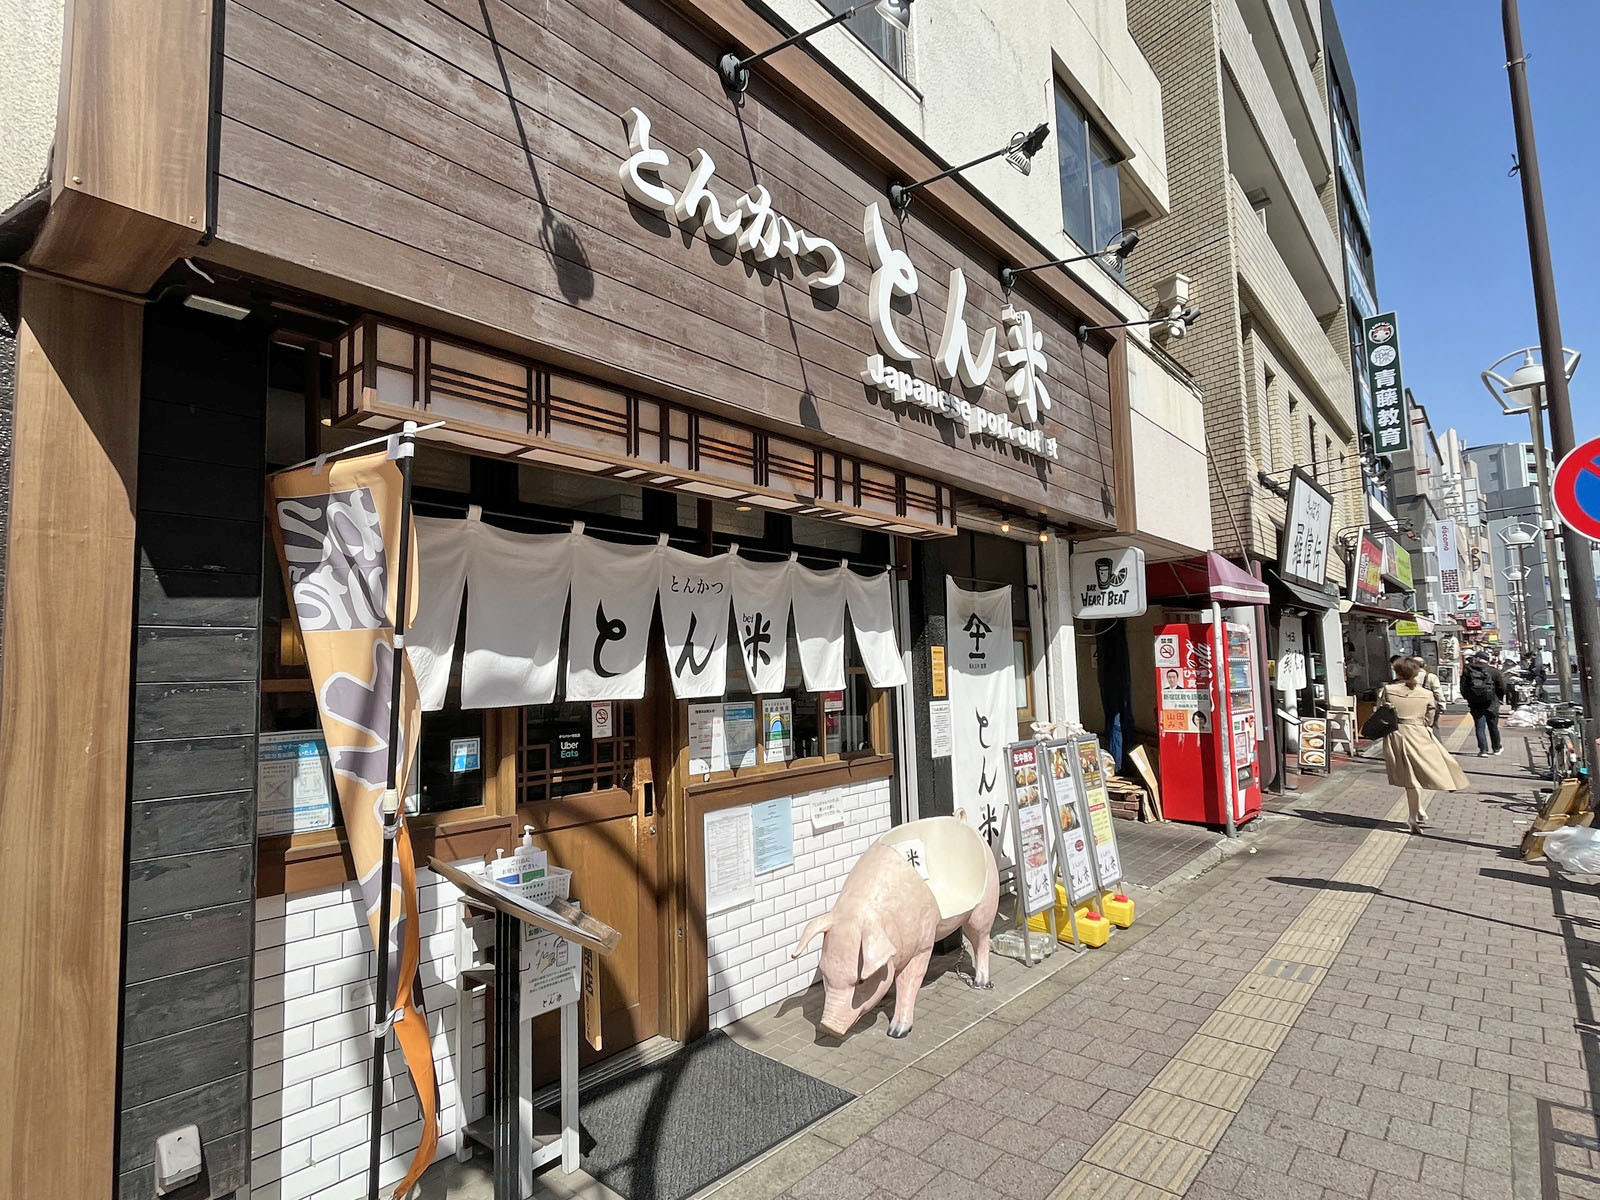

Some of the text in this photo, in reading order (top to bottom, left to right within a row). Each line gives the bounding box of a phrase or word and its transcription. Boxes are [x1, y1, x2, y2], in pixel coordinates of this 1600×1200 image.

[618, 106, 846, 290] とんかつ
[862, 201, 1052, 425] とん米
[862, 353, 1059, 460] Japanese pork cutlet
[1374, 368, 1401, 447] 青藤教育
[1441, 525, 1449, 552] docomo
[670, 574, 725, 595] とんかつ
[1081, 589, 1130, 607] HEART BEAT
[592, 598, 771, 679] とん米
[1167, 712, 1185, 721] 山田
[560, 741, 579, 750] Uber
[560, 750, 579, 758] Eats
